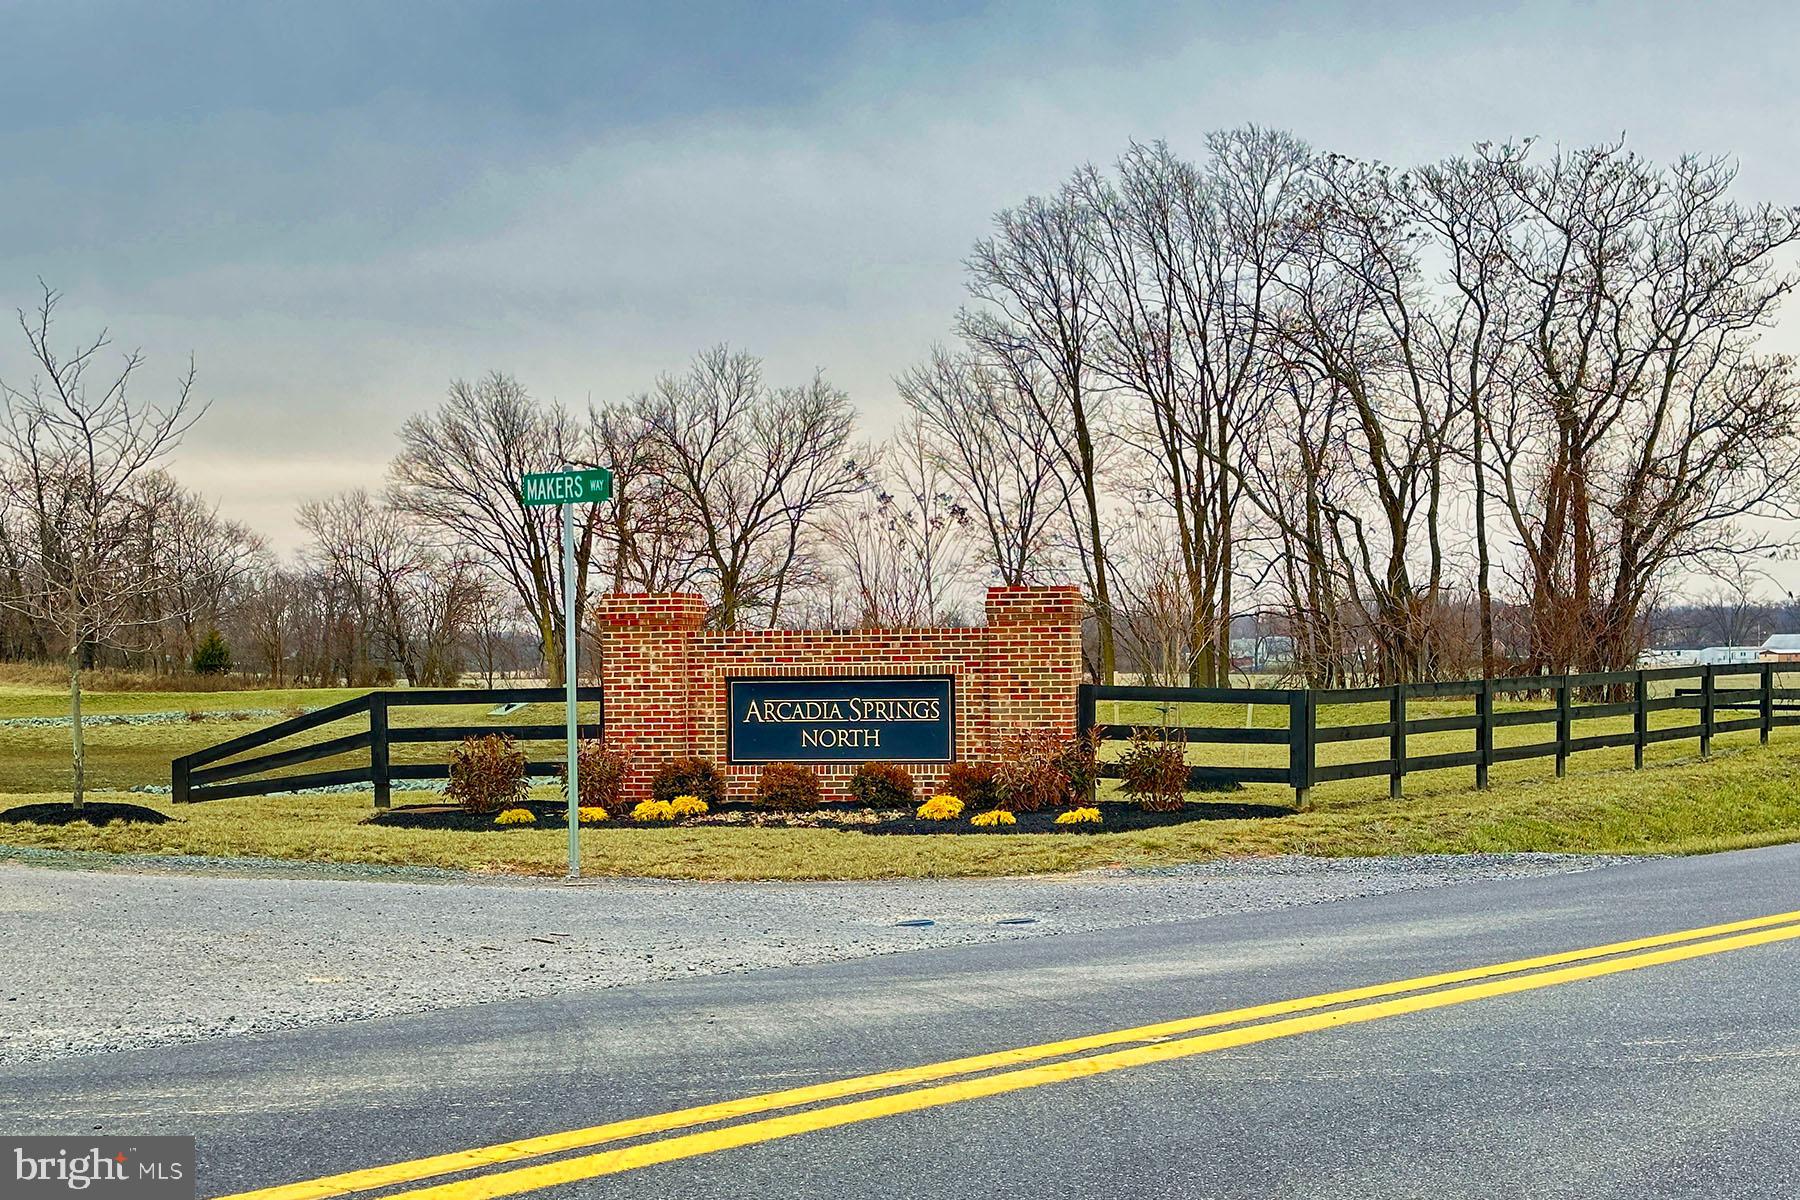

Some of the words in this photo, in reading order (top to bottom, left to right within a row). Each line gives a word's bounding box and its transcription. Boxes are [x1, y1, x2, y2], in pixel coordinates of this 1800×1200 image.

[527, 475, 583, 500] MAKERS
[589, 479, 604, 491] WAY
[743, 699, 844, 723] ARCADIA
[849, 698, 940, 722] SPRINGS
[801, 729, 880, 748] NORTH
